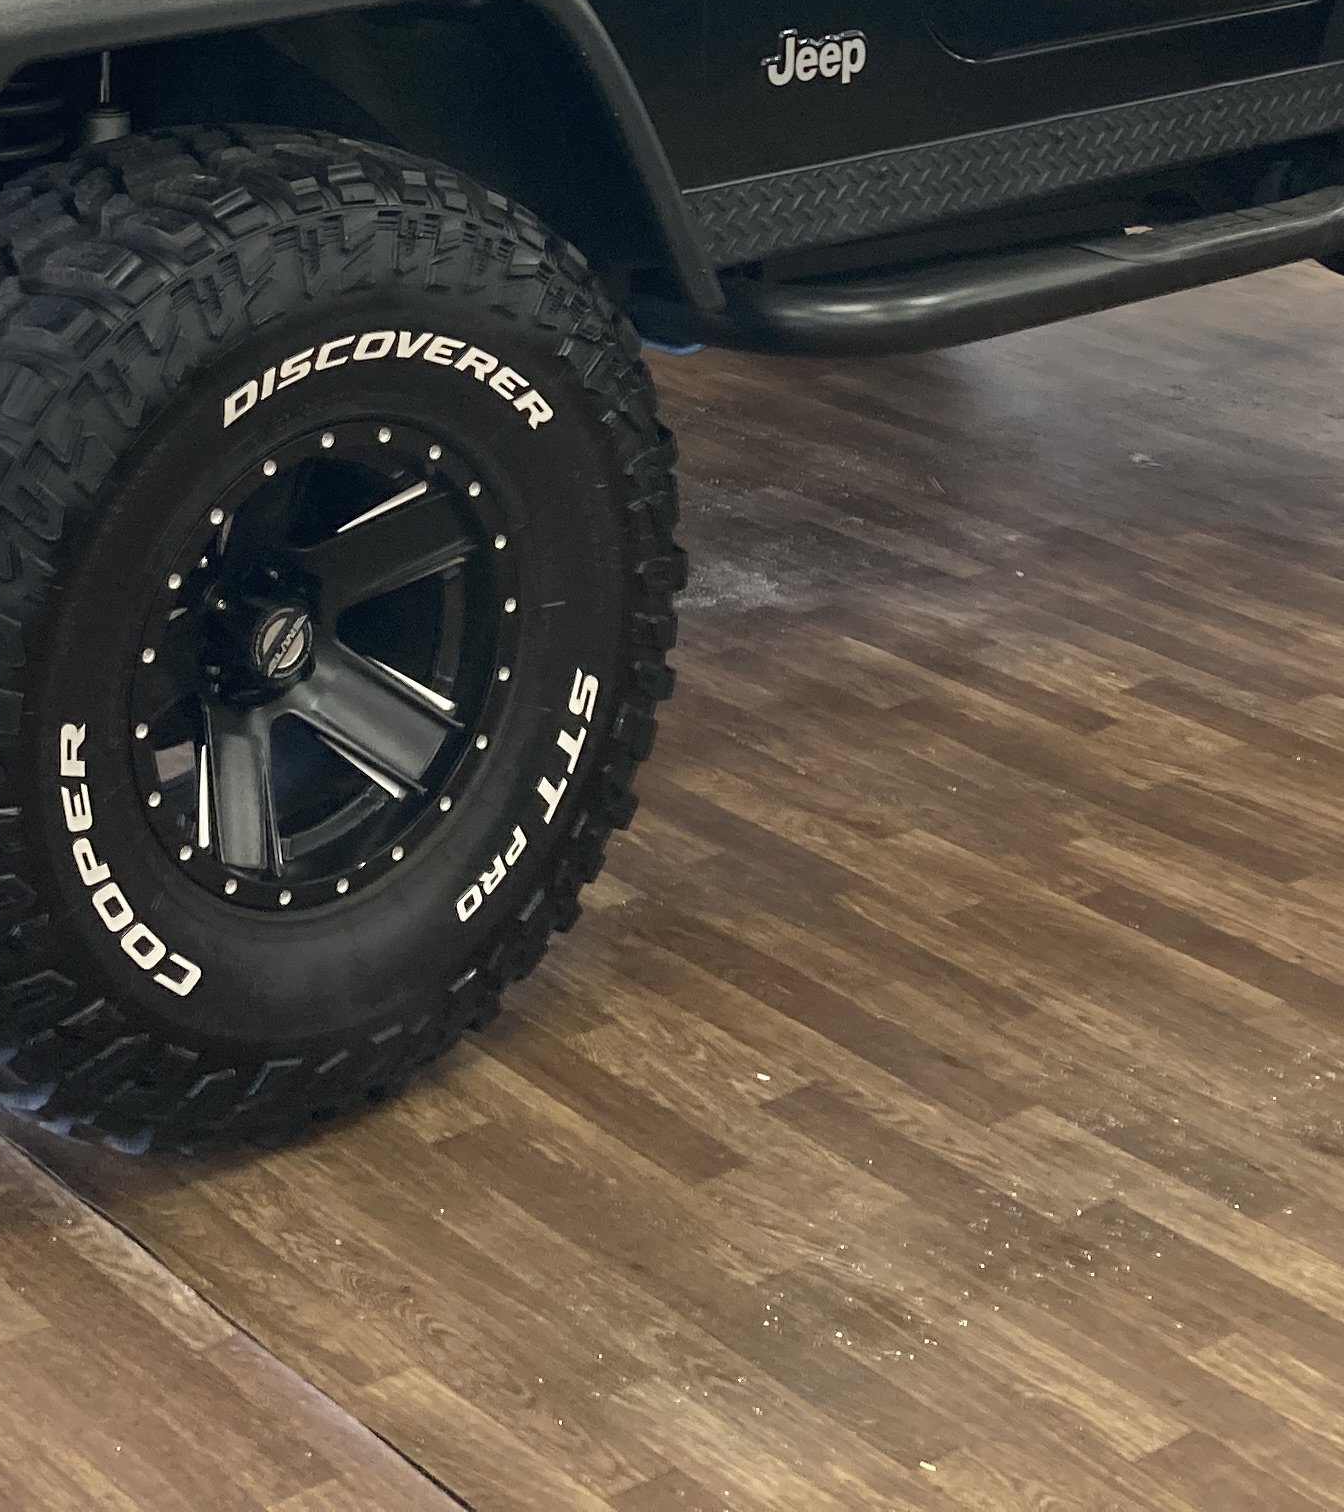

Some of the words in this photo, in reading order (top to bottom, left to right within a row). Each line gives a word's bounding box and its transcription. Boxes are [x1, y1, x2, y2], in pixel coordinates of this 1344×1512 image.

[761, 29, 867, 86] Jeep
[222, 330, 554, 430] DISCOVERER
[536, 668, 599, 824] STT
[60, 723, 202, 997] COOPER
[456, 826, 527, 923] PRO
